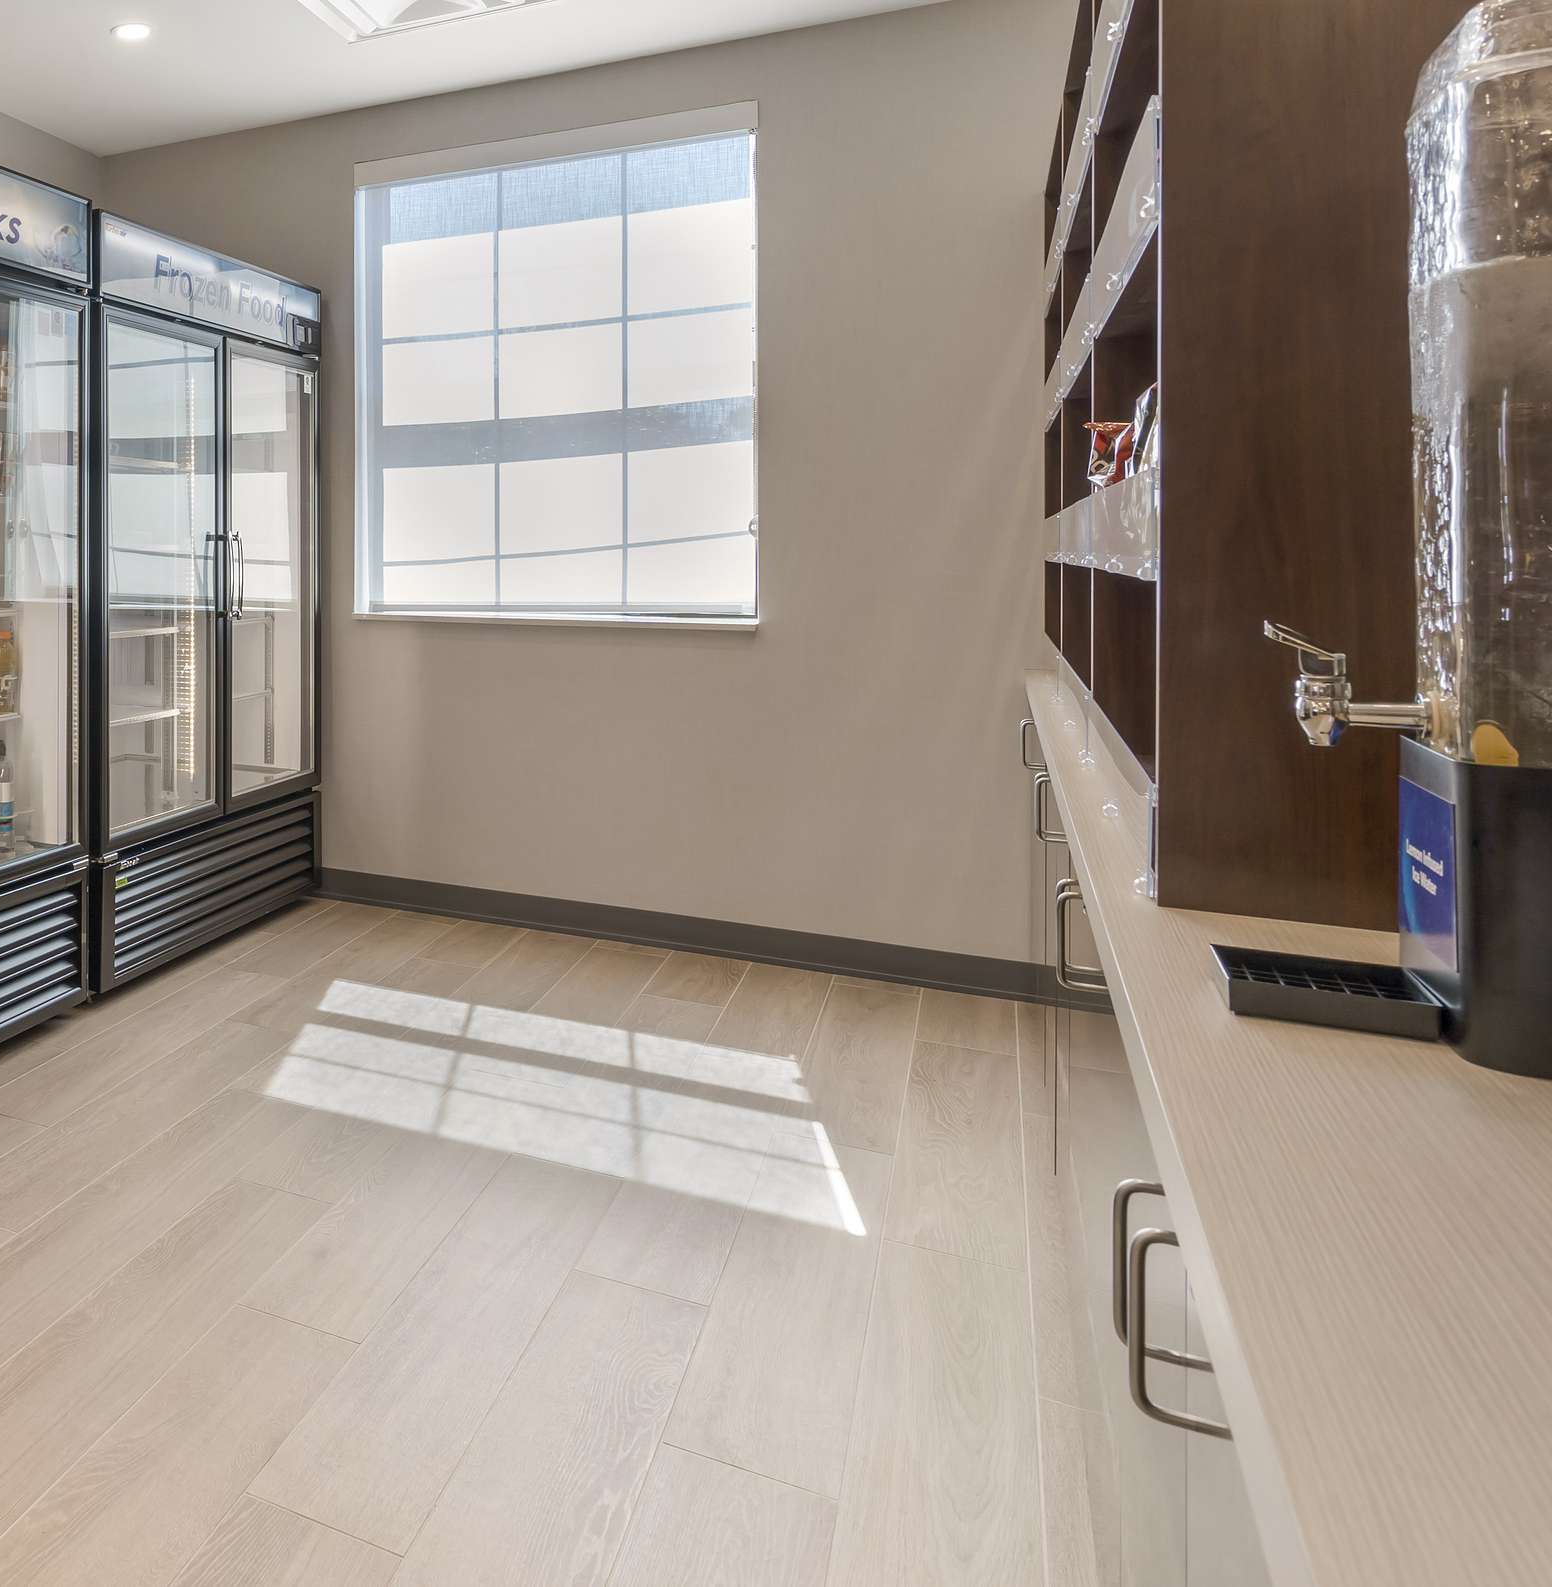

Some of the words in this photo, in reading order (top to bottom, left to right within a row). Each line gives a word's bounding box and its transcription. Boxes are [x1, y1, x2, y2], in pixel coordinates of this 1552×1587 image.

[153, 253, 232, 312] Frozen
[238, 281, 287, 330] Food
[1411, 864, 1420, 885] Ice
[1420, 871, 1437, 896] Water
